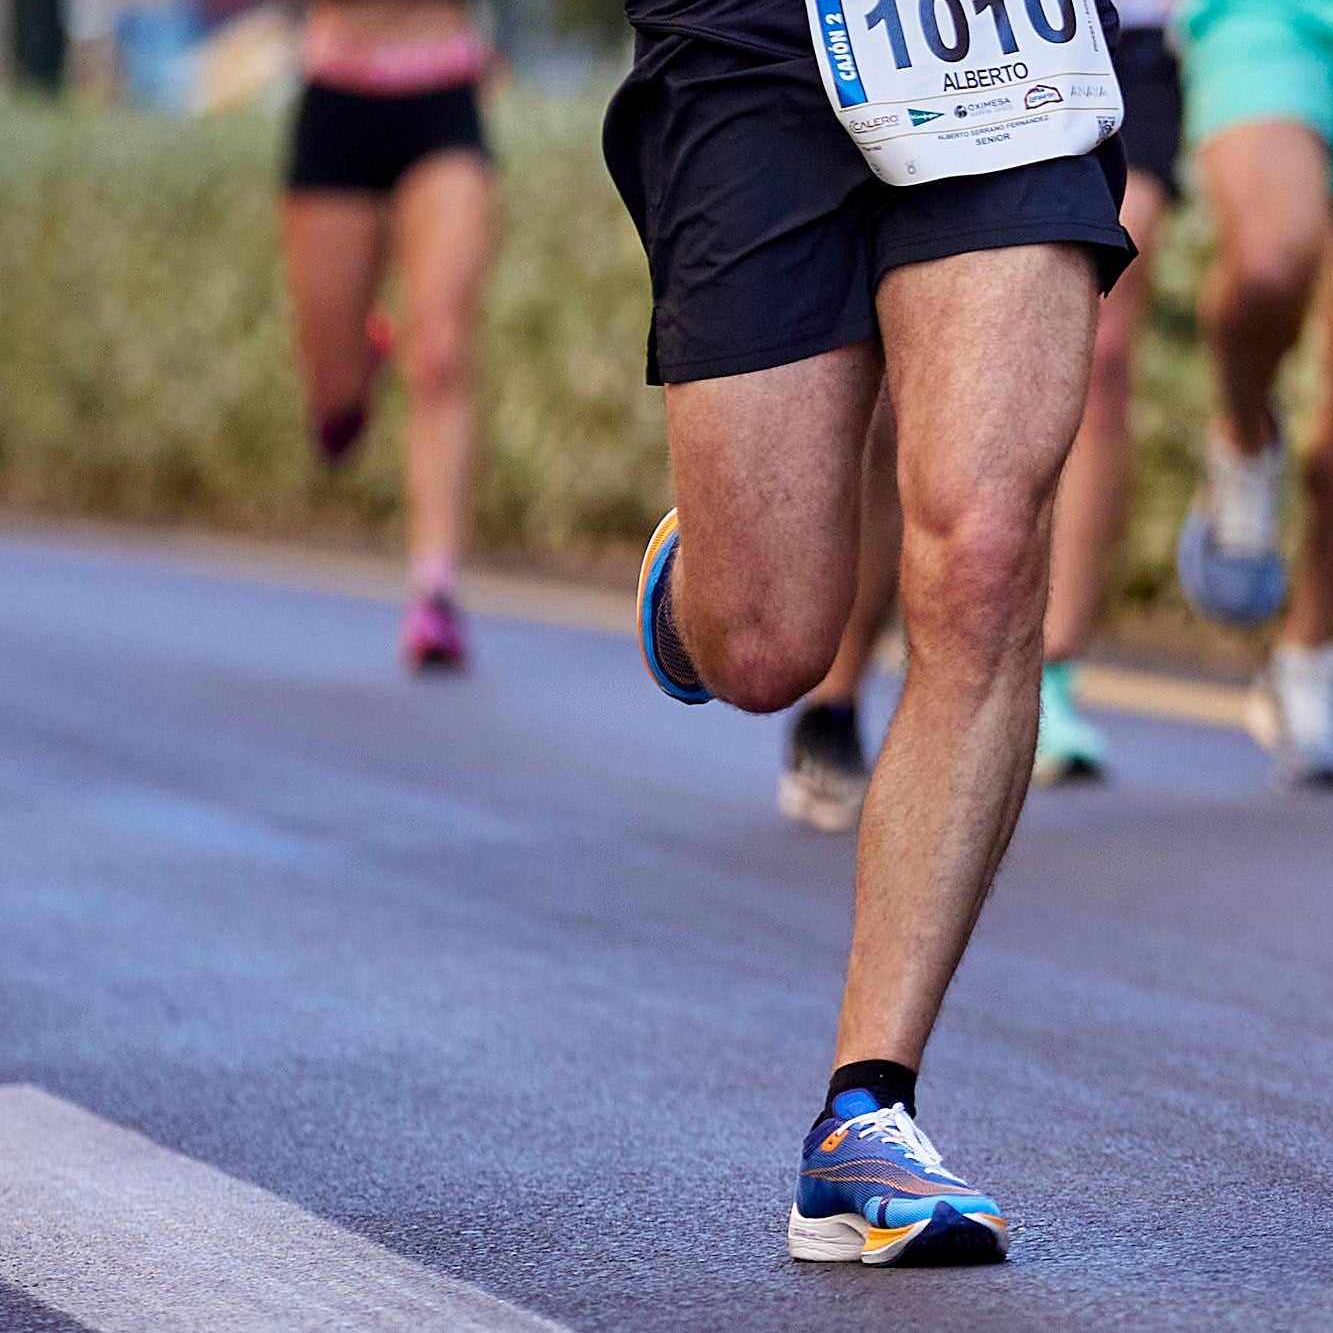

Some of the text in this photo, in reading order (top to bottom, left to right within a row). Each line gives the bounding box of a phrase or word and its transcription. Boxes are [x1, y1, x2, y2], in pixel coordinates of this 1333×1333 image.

[825, 13, 858, 81] CAJÓN 2
[943, 62, 1029, 92] ALBERTO
[968, 97, 1011, 111] OXIMESA
[975, 133, 1010, 146] SENIOR
